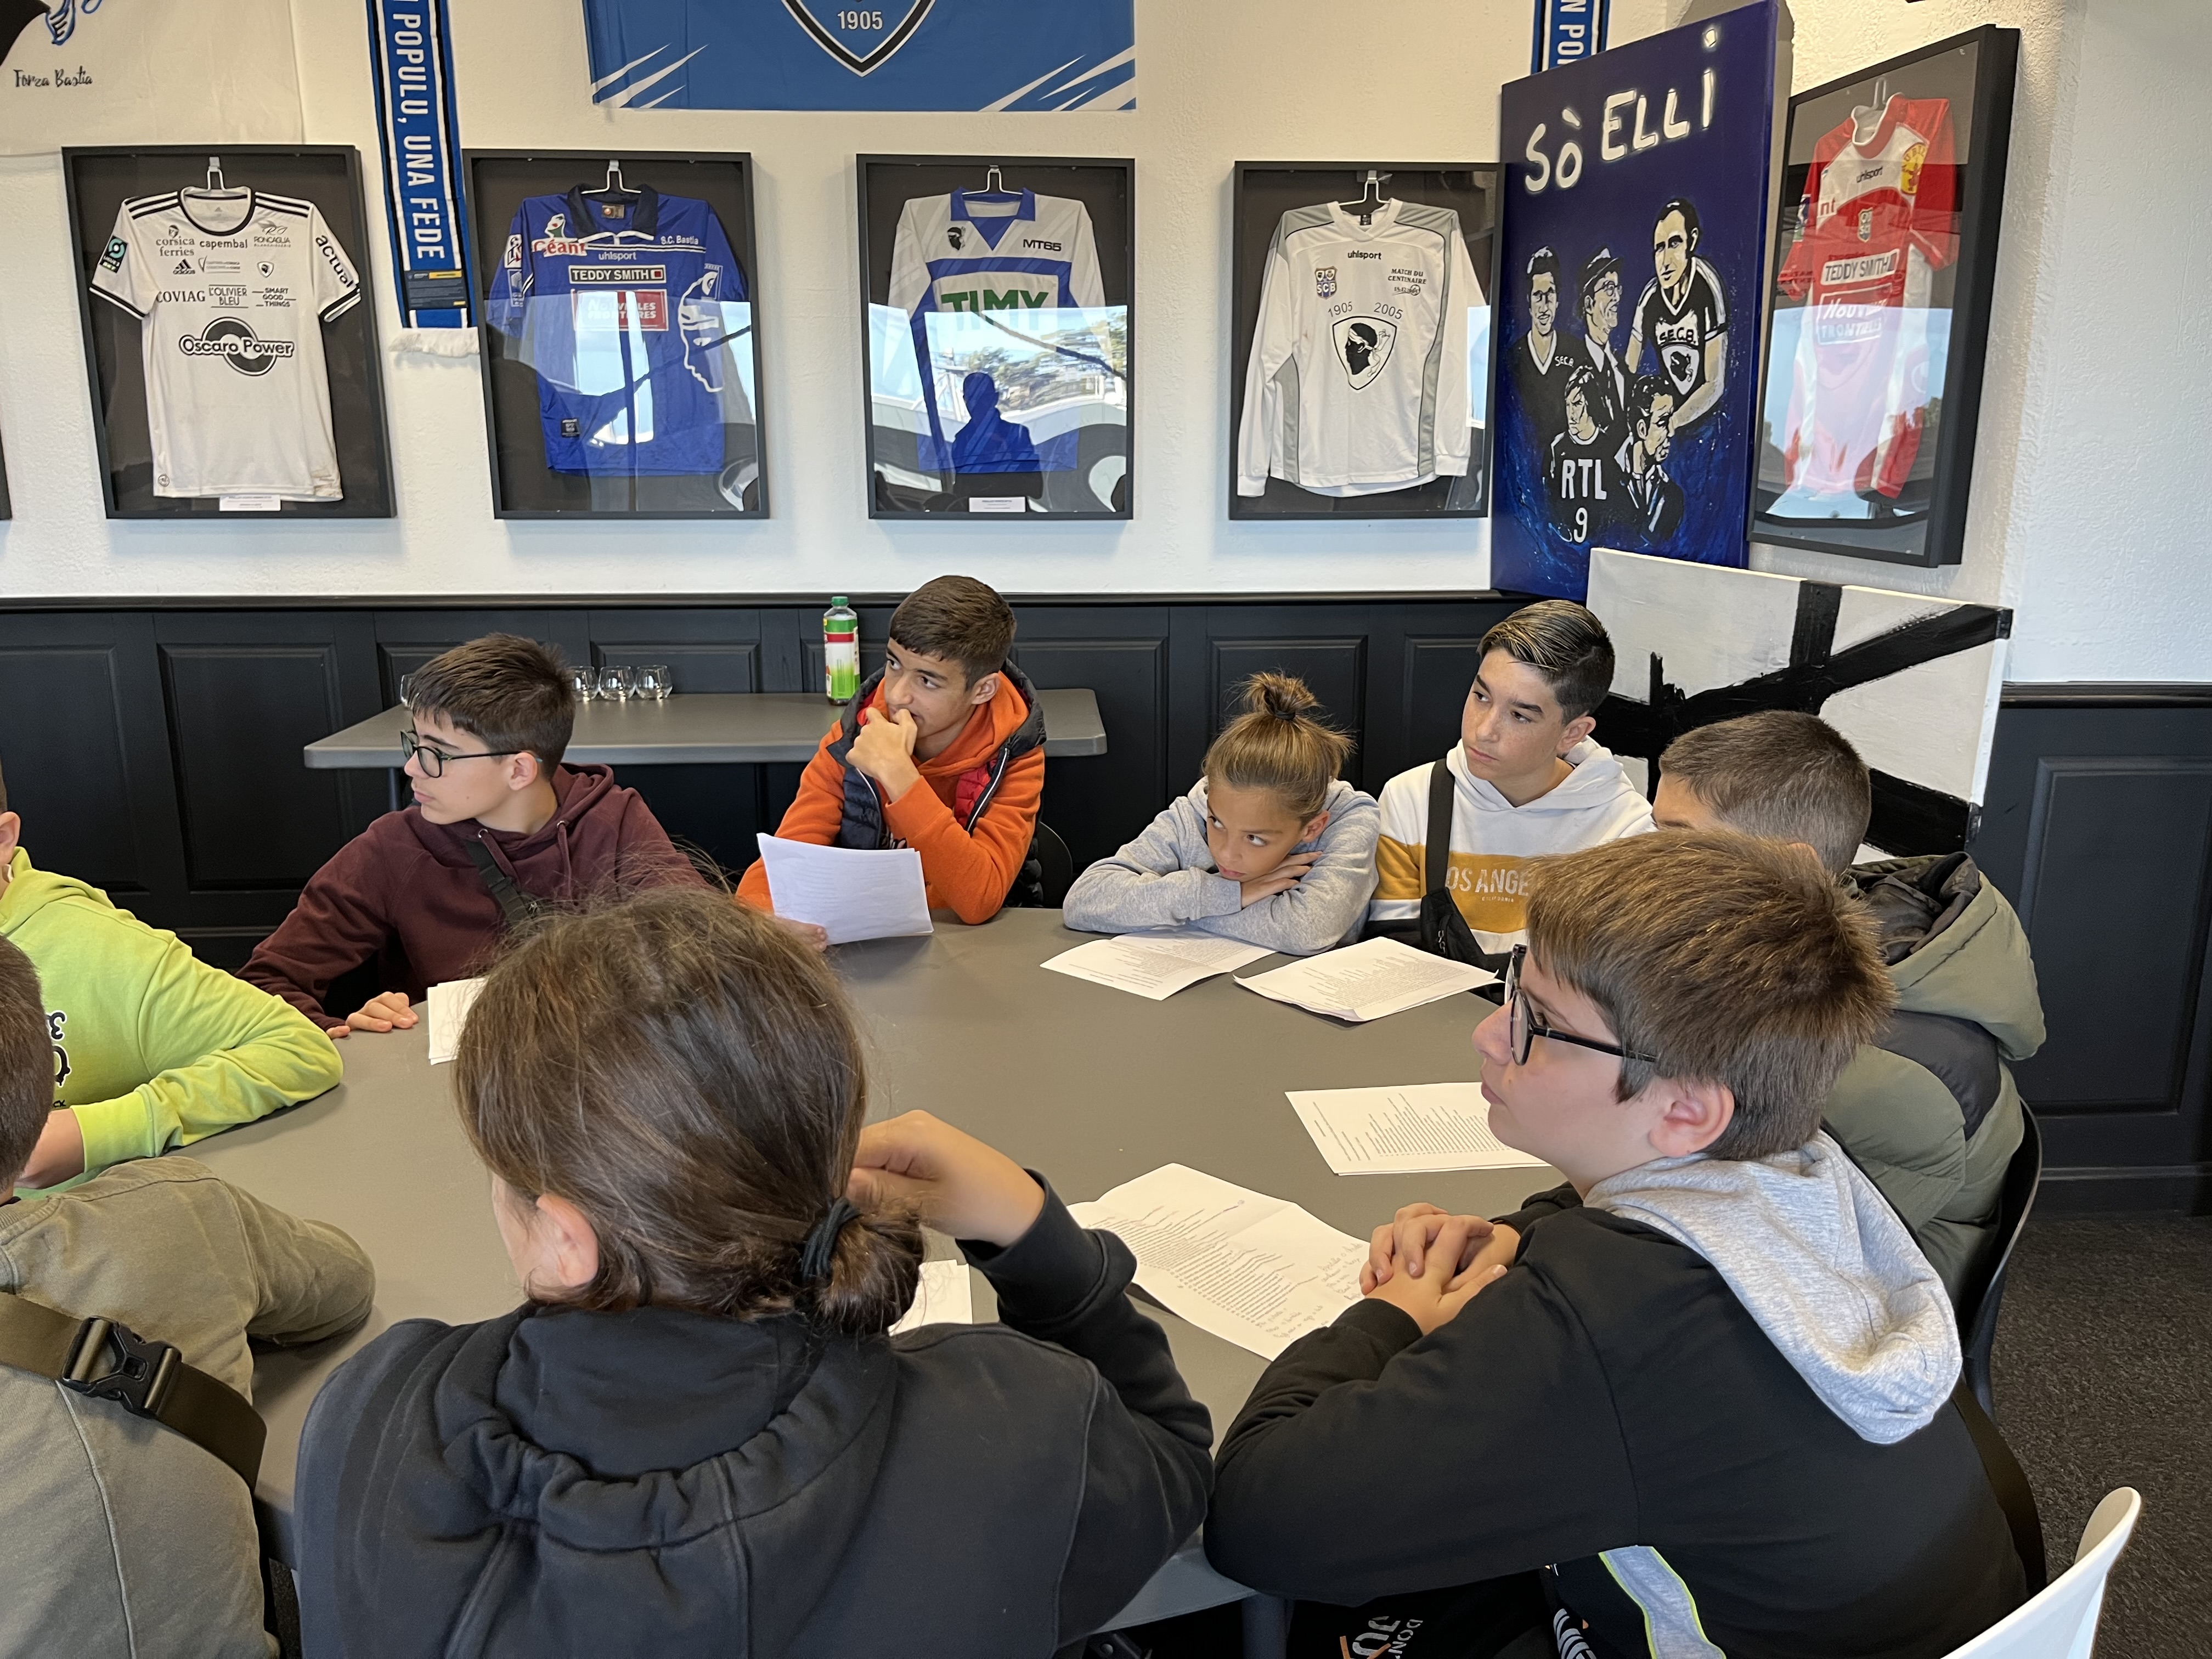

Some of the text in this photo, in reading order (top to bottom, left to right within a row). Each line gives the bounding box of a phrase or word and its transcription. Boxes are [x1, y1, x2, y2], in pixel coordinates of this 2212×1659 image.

[837, 10, 883, 30] 1905
[13, 65, 93, 87] Forza Bastia
[393, 14, 429, 123] POPULU,
[403, 136, 435, 186] UNA
[410, 198, 445, 259] FEDE
[155, 235, 195, 246] corsica
[199, 239, 247, 250] capembal
[676, 235, 699, 245] Bastia
[160, 246, 195, 256] ferries
[599, 252, 636, 261] uhlsport
[1348, 250, 1382, 259] uhlsport
[315, 235, 354, 288] actual
[572, 269, 649, 280] TEDDY SMITH
[1387, 275, 1427, 284] CENTENAIRE
[1825, 262, 1858, 282] TEDDY
[1317, 282, 1336, 294] SCB
[219, 296, 239, 306] BLEU
[1328, 301, 1403, 319] 1905 2005
[183, 338, 292, 354] Oscaro Power
[1561, 459, 1607, 500] RTL
[1573, 507, 1588, 543] 9
[1446, 866, 1529, 896] OS ANGE
